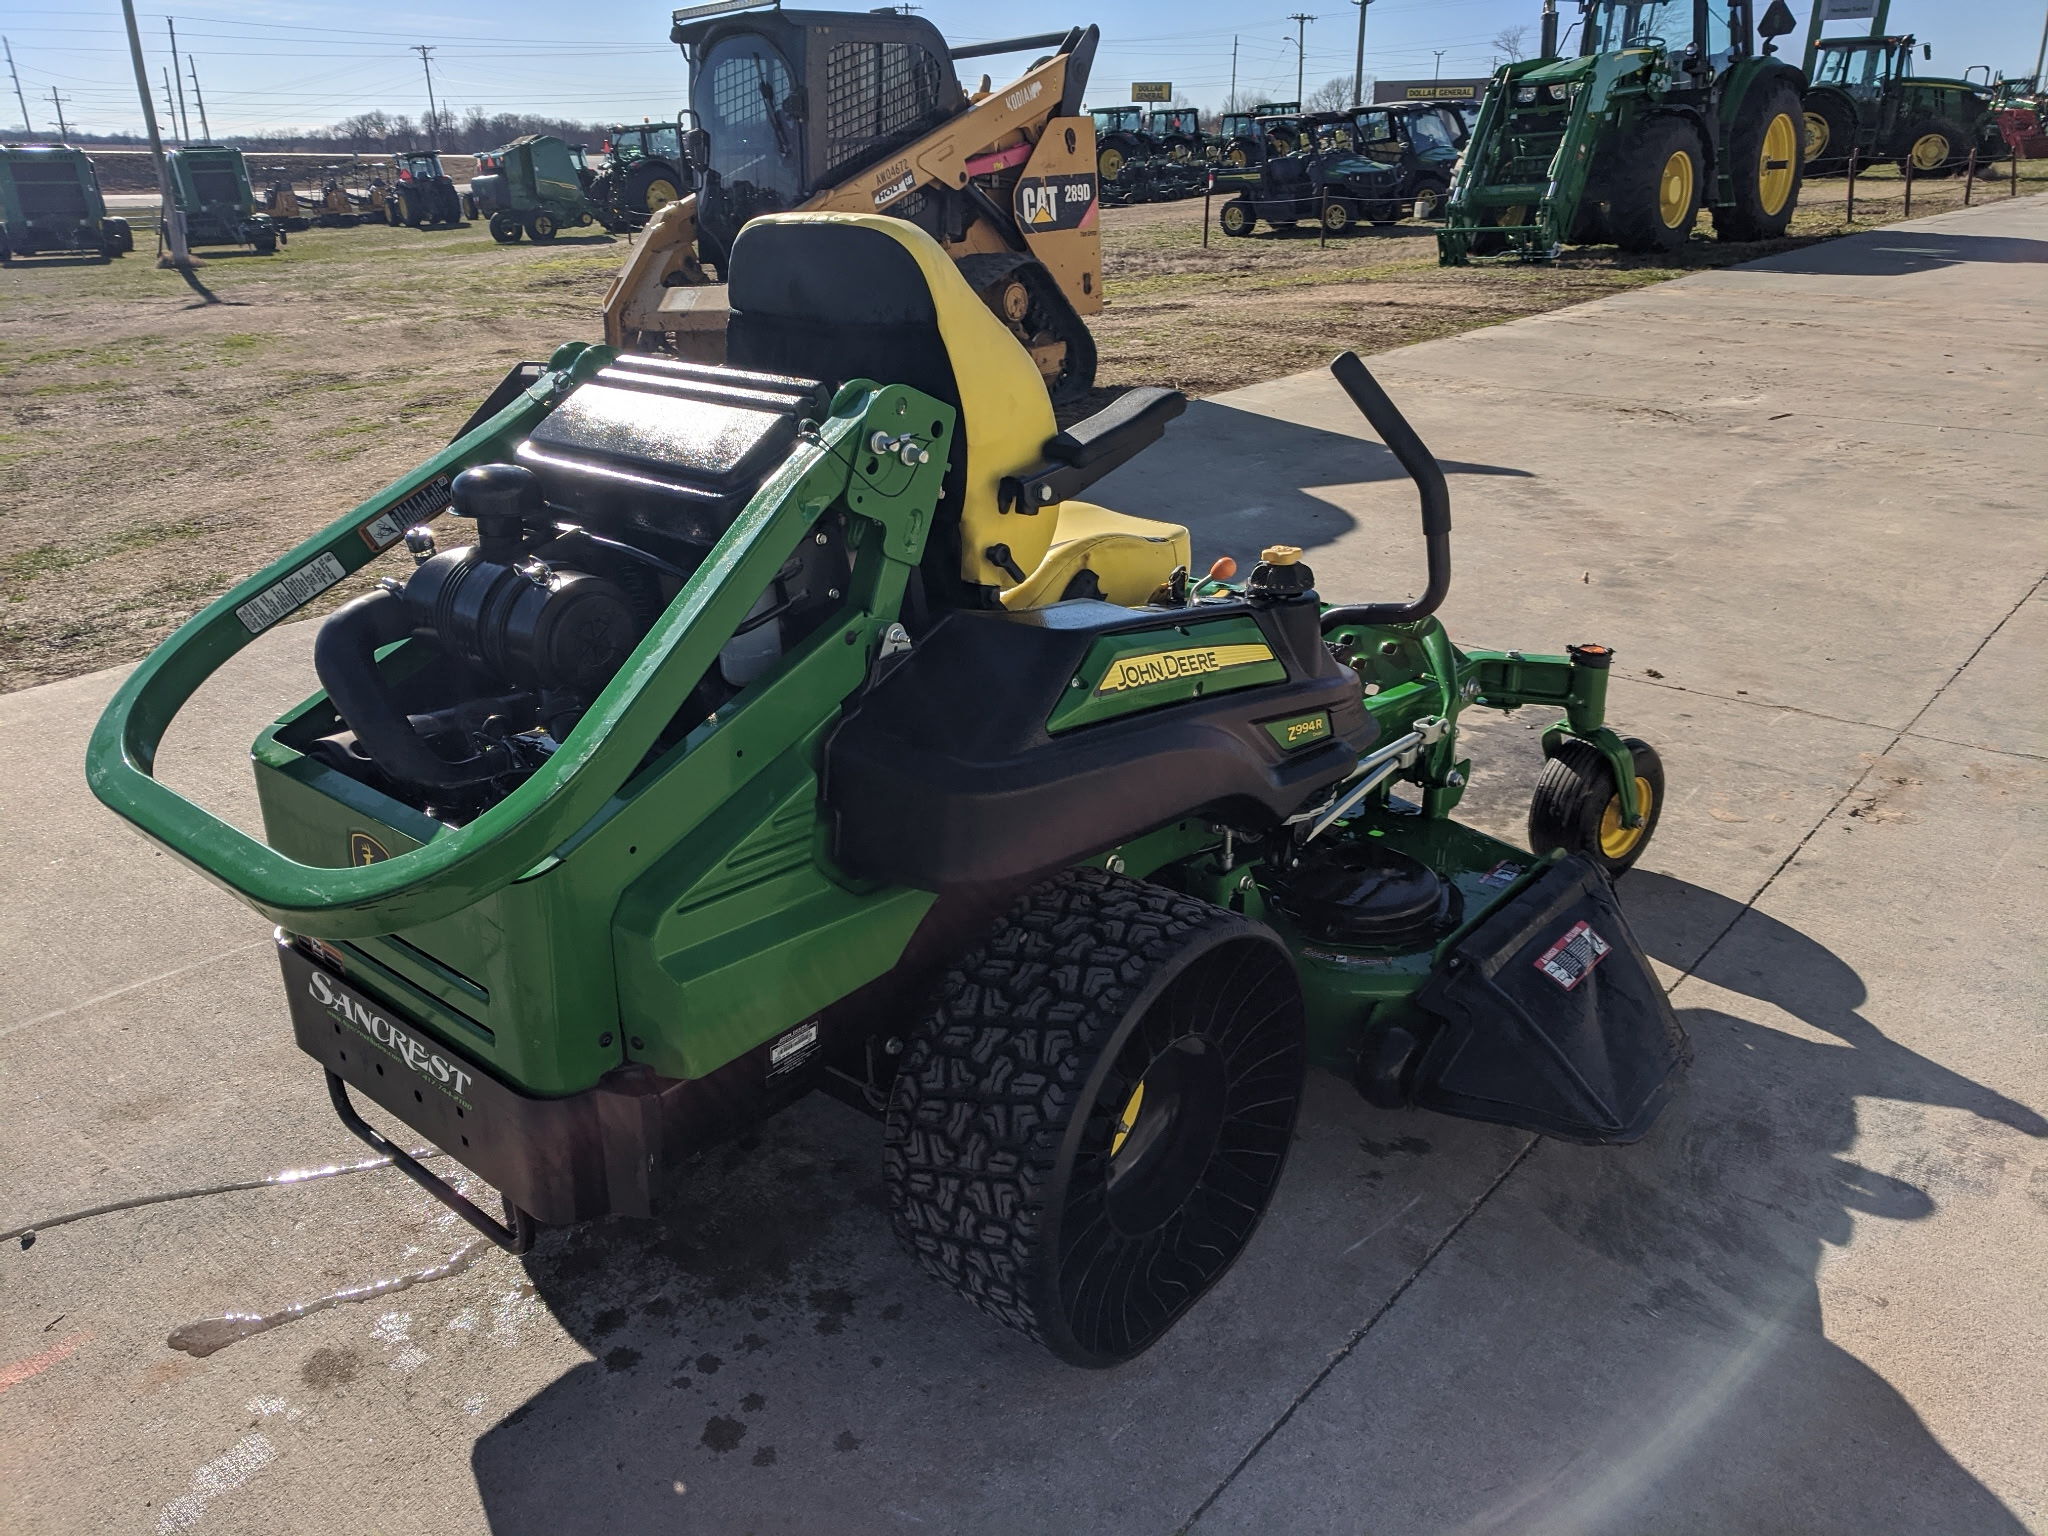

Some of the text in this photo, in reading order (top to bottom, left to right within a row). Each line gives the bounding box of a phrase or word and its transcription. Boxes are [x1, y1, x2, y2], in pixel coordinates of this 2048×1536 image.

[1408, 88, 1472, 97] DOLLAR GENERAL
[878, 183, 900, 201] HOLT
[1022, 183, 1091, 224] CAT 289D
[1118, 651, 1219, 687] JOHN DEERE
[1287, 718, 1323, 742] Z994R
[308, 971, 472, 1095] SANCREST
